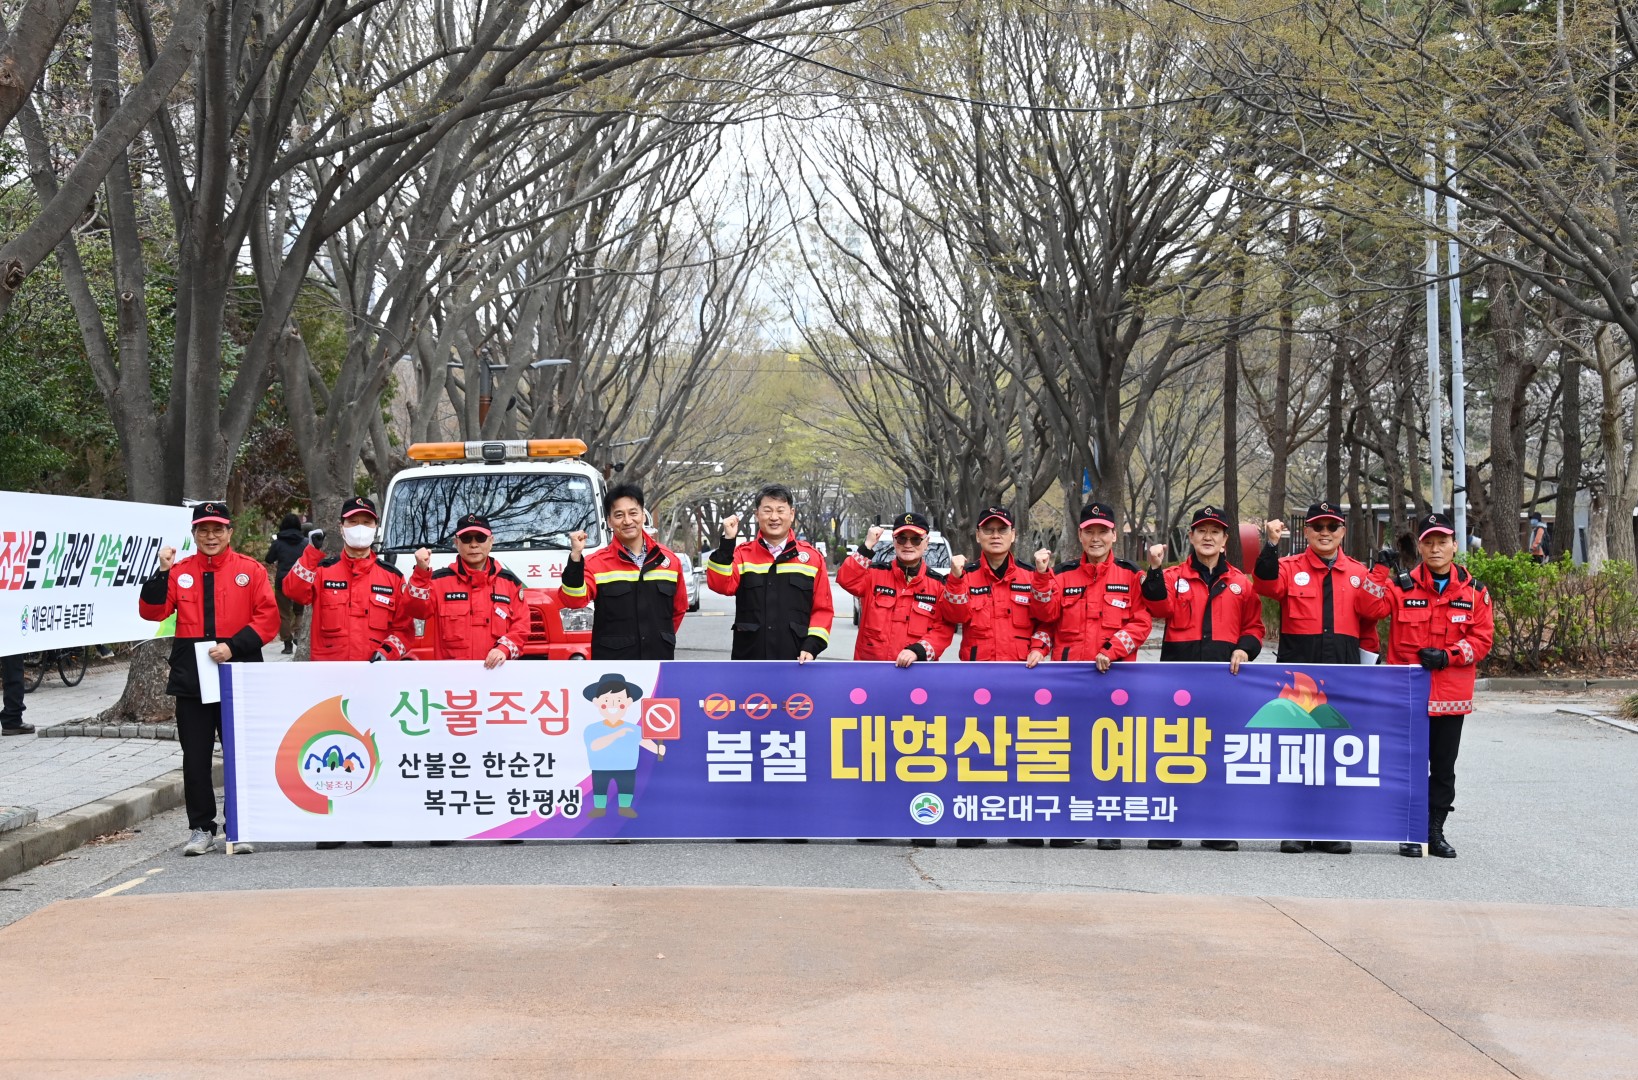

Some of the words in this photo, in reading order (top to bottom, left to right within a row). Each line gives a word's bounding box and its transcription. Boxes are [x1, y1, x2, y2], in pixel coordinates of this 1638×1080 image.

[41, 532, 95, 589] 산과의
[31, 605, 63, 633] 해운대구
[64, 602, 95, 630] 늘푸른과
[390, 688, 570, 737] 산불조심
[398, 752, 471, 779] 산불은
[482, 751, 556, 779] 한순간
[706, 730, 807, 782] 봄철
[830, 715, 1071, 782] 대형산불
[1091, 716, 1212, 784] 예방
[1223, 733, 1380, 787] 캠페인
[314, 780, 353, 791] 산불조심
[424, 789, 496, 816] 복구는
[507, 788, 580, 816] 한평생
[952, 794, 1061, 822] 해운대구
[1068, 795, 1178, 823] 늘푸른과
